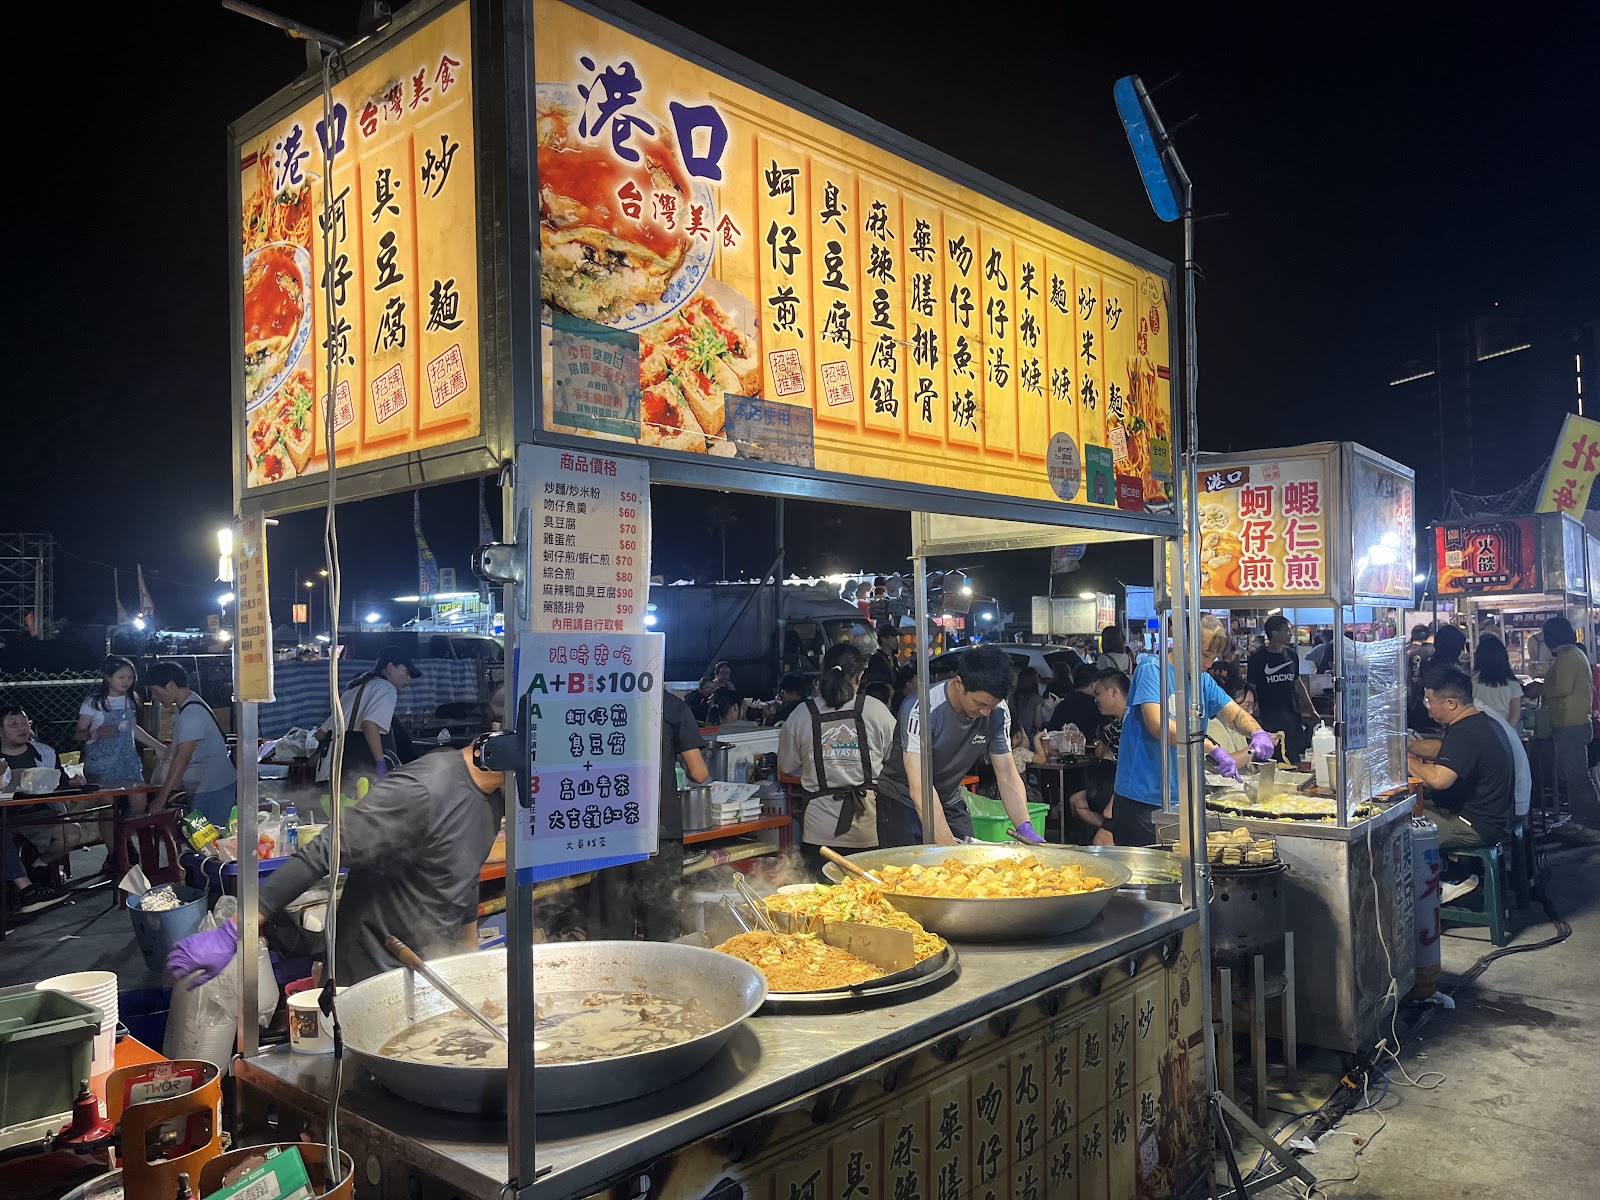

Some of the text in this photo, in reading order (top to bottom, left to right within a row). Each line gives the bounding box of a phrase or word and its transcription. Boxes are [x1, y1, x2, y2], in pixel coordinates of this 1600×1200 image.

[359, 55, 460, 138] 台灣美食
[578, 56, 729, 181] 港口
[275, 102, 348, 192] 港口
[617, 180, 742, 248] 台灣美食
[421, 135, 464, 333] 炒麵
[763, 159, 804, 339] 蚵仔煎
[318, 186, 355, 369] 蚵仔煎
[371, 169, 406, 357] 臭豆腐
[821, 180, 852, 350] 臭豆腐
[865, 200, 898, 417] 麻辣豆腐鍋
[909, 218, 938, 423] 藥膳排骨
[985, 248, 1010, 388] 丸仔湯
[430, 349, 460, 384] 招牌
[1078, 287, 1099, 411] 炒米粉
[1106, 298, 1125, 421] 炒麵
[434, 371, 464, 405] 推薦
[560, 453, 617, 477] 商品價格
[1088, 452, 1099, 462] LINE
[544, 481, 637, 503] 炒麵/炒米粉 $50
[1205, 470, 1243, 493] 港口
[543, 516, 636, 535] 臭豆腐 $70
[619, 507, 635, 519] $60
[543, 533, 636, 551] 雞蛋煎 $60
[1240, 485, 1274, 588] 蚵仔煎
[1284, 481, 1320, 588] 蝦仁煎
[543, 549, 632, 566] 蚵仔煎/蝦仁煎 $70
[543, 567, 632, 582] 綜合煎 $80
[543, 584, 633, 599] 麻辣鴨血臭豆腐 $90
[543, 600, 633, 614] 藥膳排骨 $90
[550, 644, 632, 665] 限時爽吃
[527, 673, 585, 694] A+B
[597, 672, 654, 692] $100
[566, 704, 628, 727] 蚵仔煎
[569, 733, 625, 757] 臭豆腐
[809, 749, 850, 760] HALAYAS
[560, 775, 629, 800] 高山青茶
[549, 802, 640, 830] 大吉嶺紅茶
[1138, 1000, 1156, 1126] 炒麵
[1111, 1014, 1130, 1148] 炒米粉
[977, 1081, 1002, 1200] 吻仔
